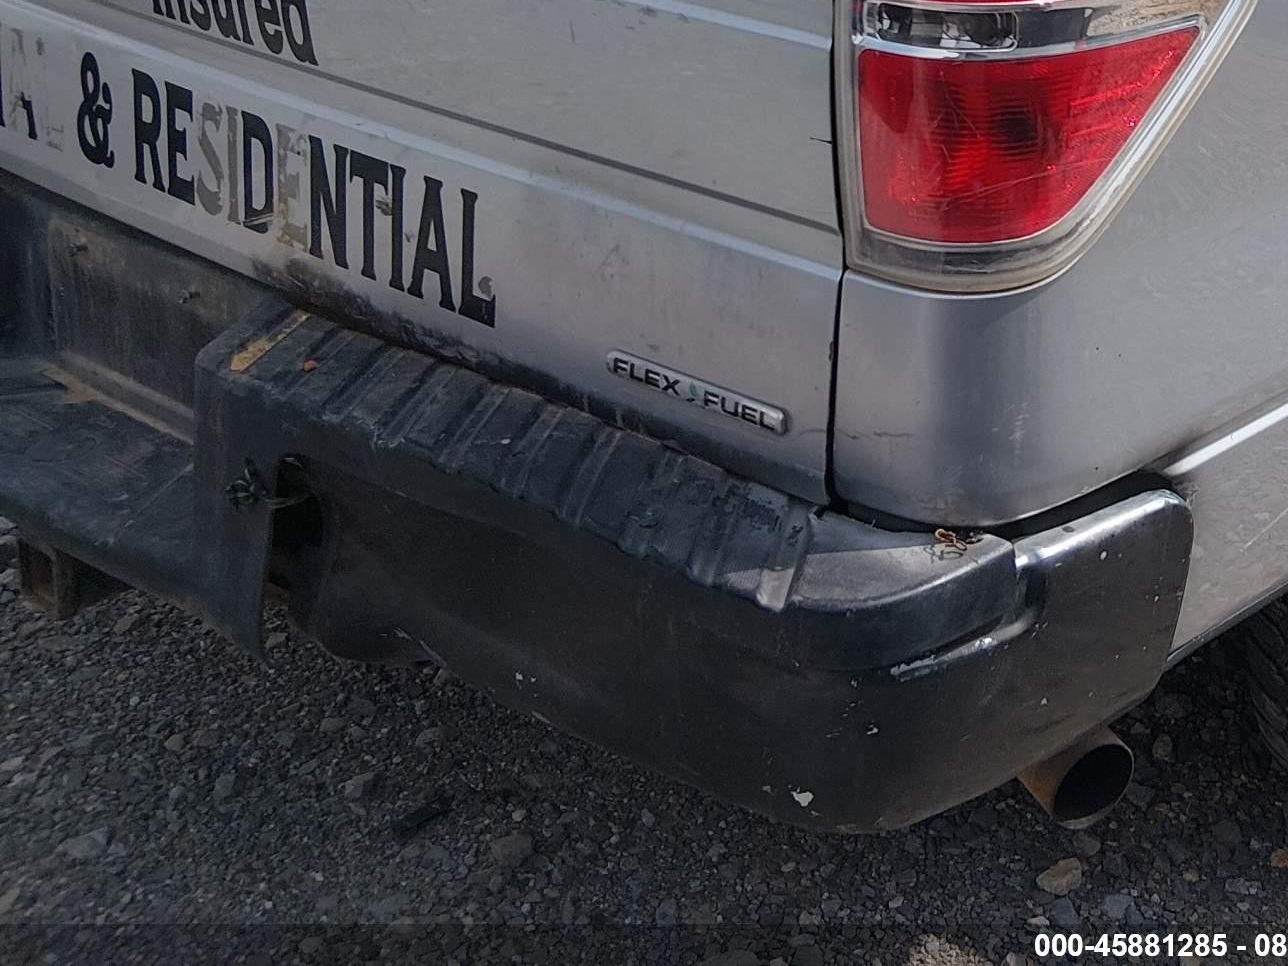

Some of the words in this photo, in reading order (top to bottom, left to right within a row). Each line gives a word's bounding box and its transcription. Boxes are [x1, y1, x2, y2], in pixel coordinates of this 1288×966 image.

[76, 51, 115, 168] &
[131, 67, 497, 329] RESIDENTIAL
[613, 357, 681, 396] FLEX
[702, 390, 776, 431] FUEL
